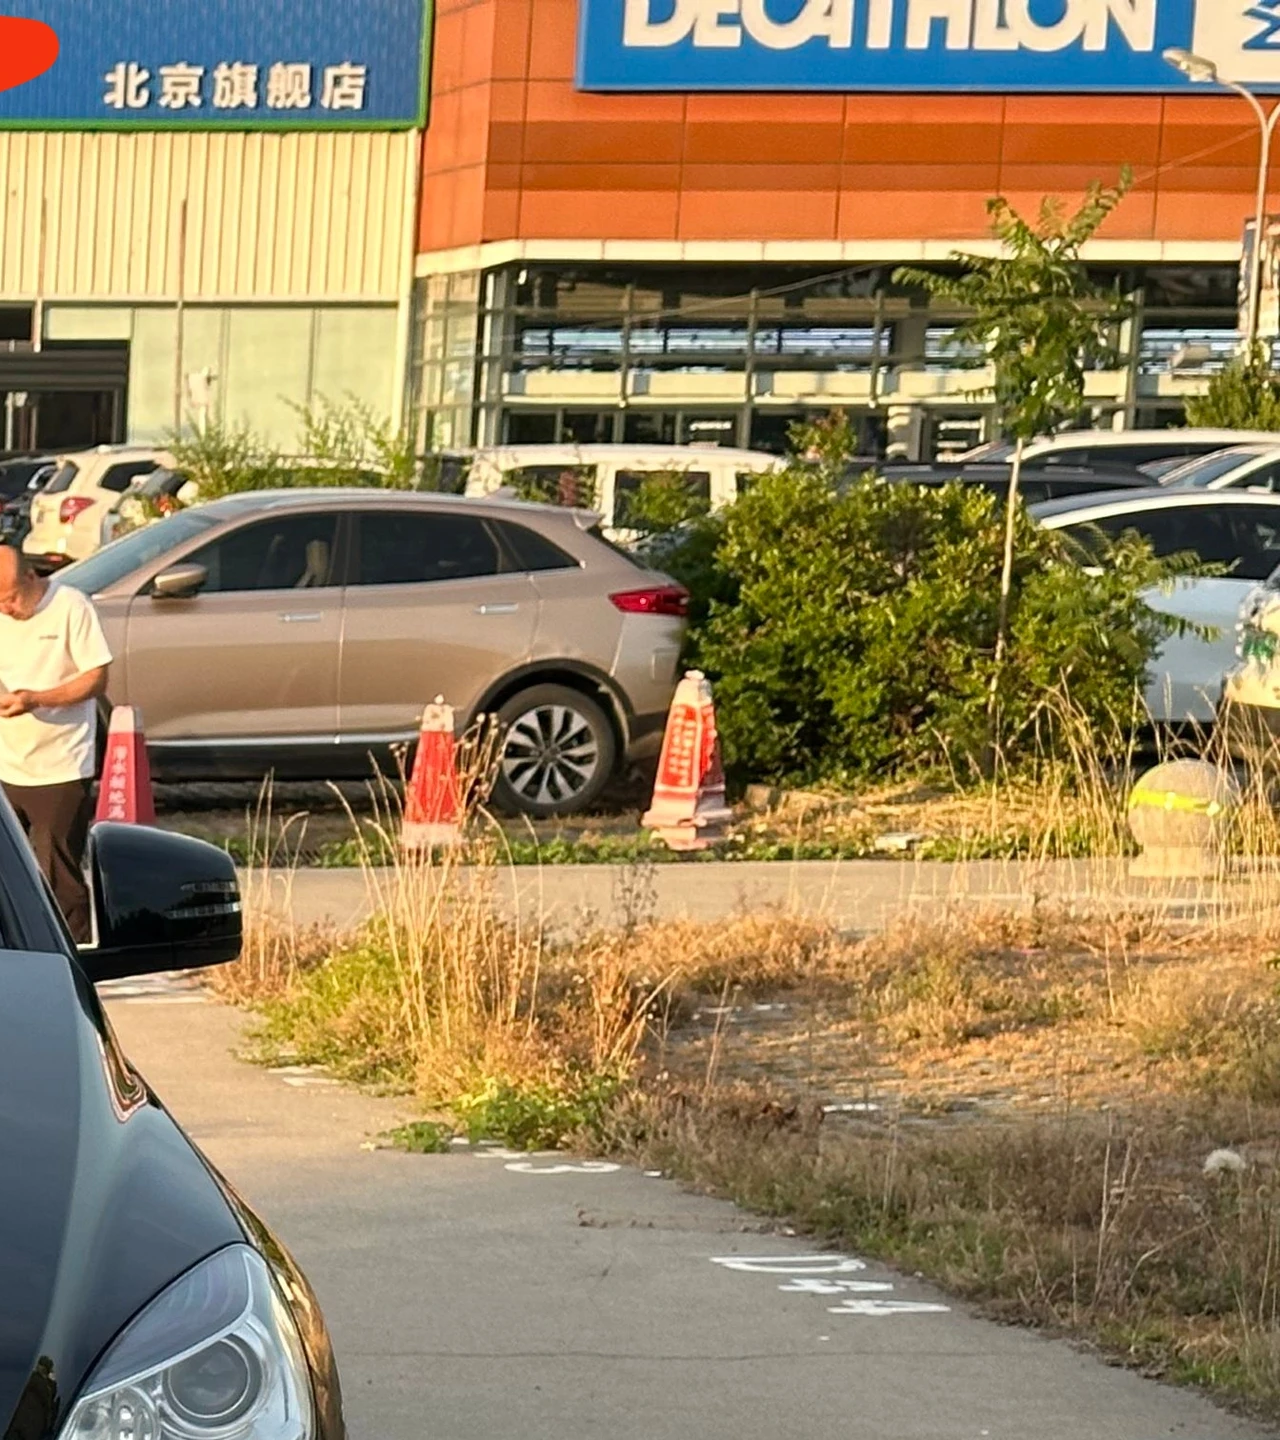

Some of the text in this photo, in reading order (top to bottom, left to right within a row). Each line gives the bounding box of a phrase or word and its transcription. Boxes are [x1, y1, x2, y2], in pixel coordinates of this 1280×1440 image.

[103, 60, 367, 109] 北京旗舰店
